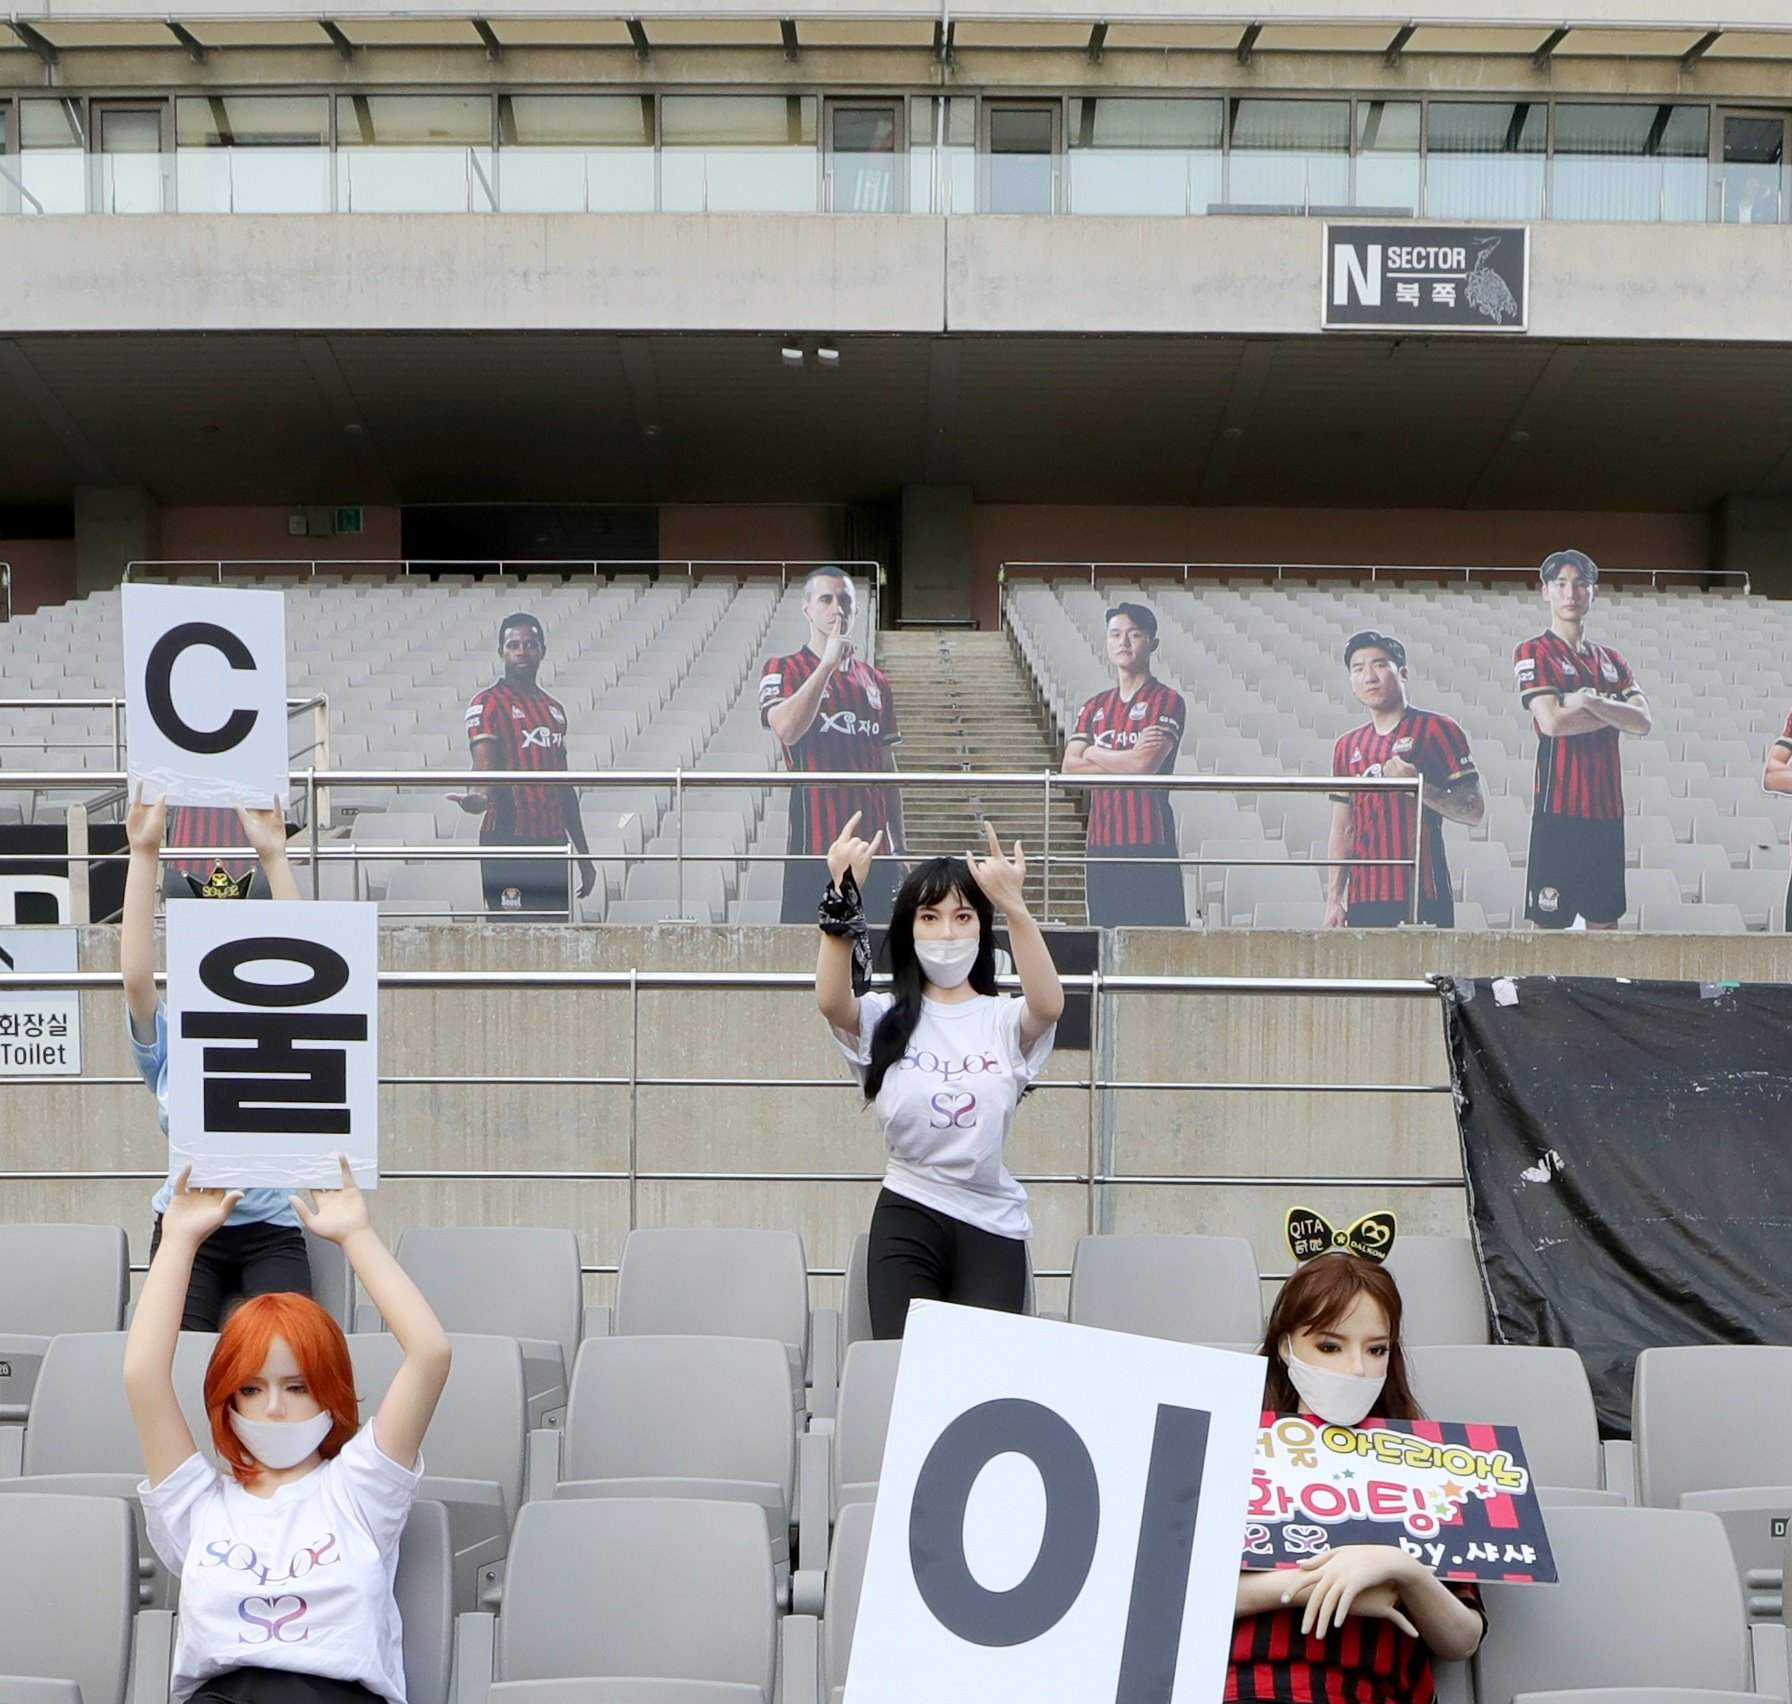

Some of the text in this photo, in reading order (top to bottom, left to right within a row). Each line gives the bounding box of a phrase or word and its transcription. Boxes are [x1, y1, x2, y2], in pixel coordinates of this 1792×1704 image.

[1333, 244, 1465, 306] N SECTOR
[146, 623, 258, 754] C
[0, 1043, 66, 1065] Toilet
[181, 937, 367, 1134] 울
[1290, 1219, 1324, 1238] QITA
[1322, 1426, 1526, 1488] 아드리아노
